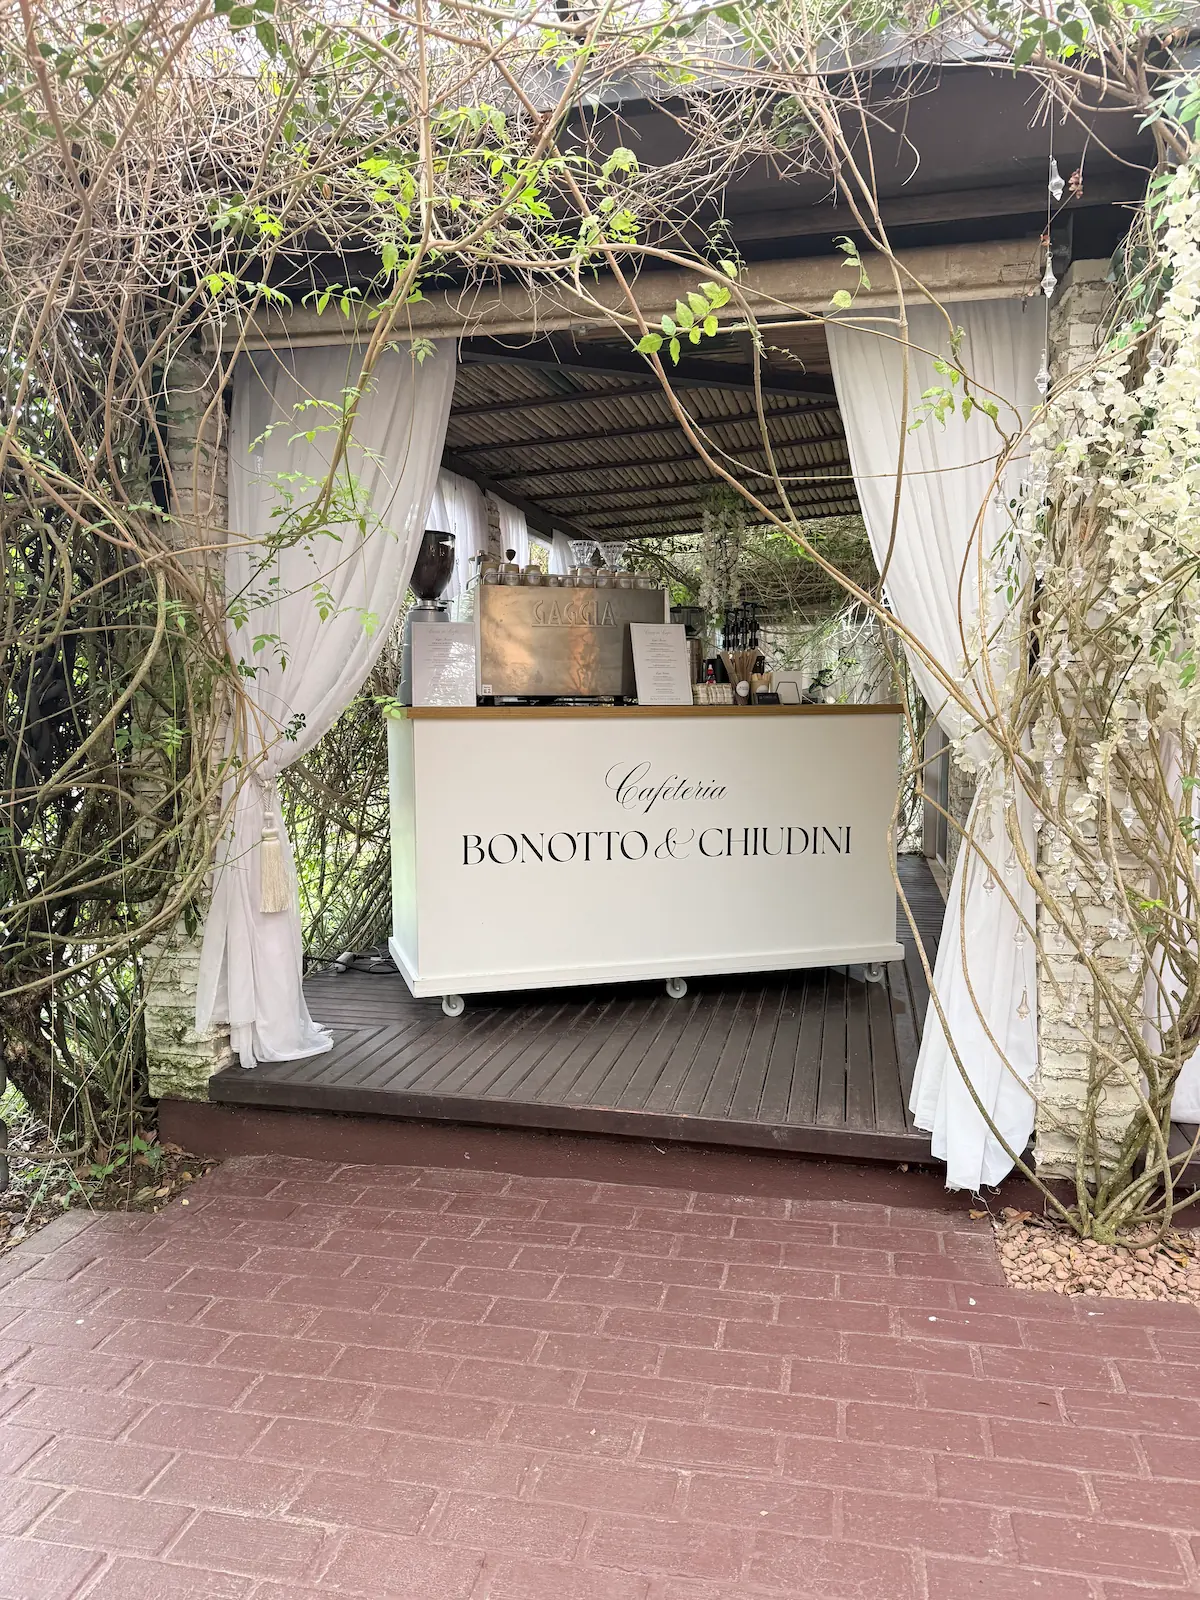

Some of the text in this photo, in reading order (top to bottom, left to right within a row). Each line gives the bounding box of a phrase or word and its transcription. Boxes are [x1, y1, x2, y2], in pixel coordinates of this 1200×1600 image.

[532, 600, 617, 627] GAGGIA
[604, 760, 729, 815] Cafeteria
[462, 825, 852, 866] BONOTTO & CHIUDINI
